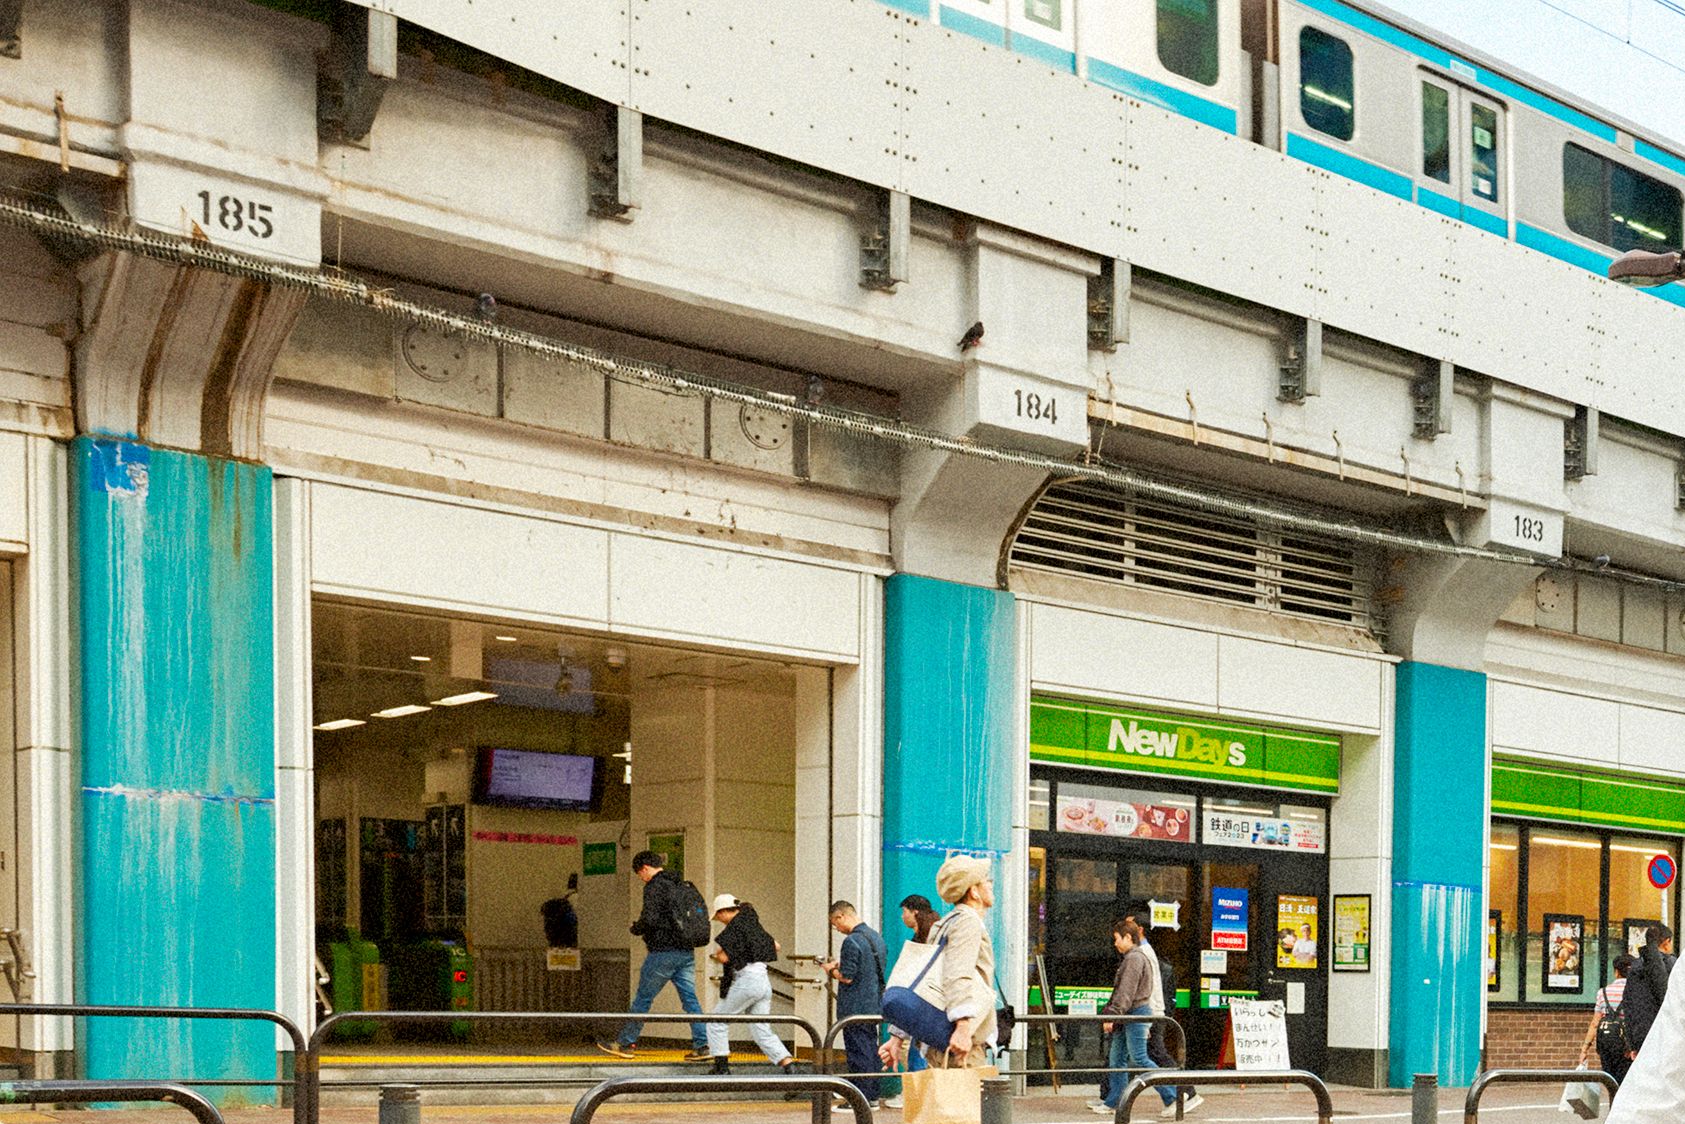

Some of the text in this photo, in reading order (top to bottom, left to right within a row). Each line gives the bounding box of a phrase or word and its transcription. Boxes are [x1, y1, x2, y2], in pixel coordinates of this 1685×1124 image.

[198, 190, 273, 239] 185
[1014, 389, 1058, 425] 184
[1514, 515, 1543, 542] 183
[1107, 718, 1246, 767] NewDays
[1210, 816, 1250, 833] 鉄道の日
